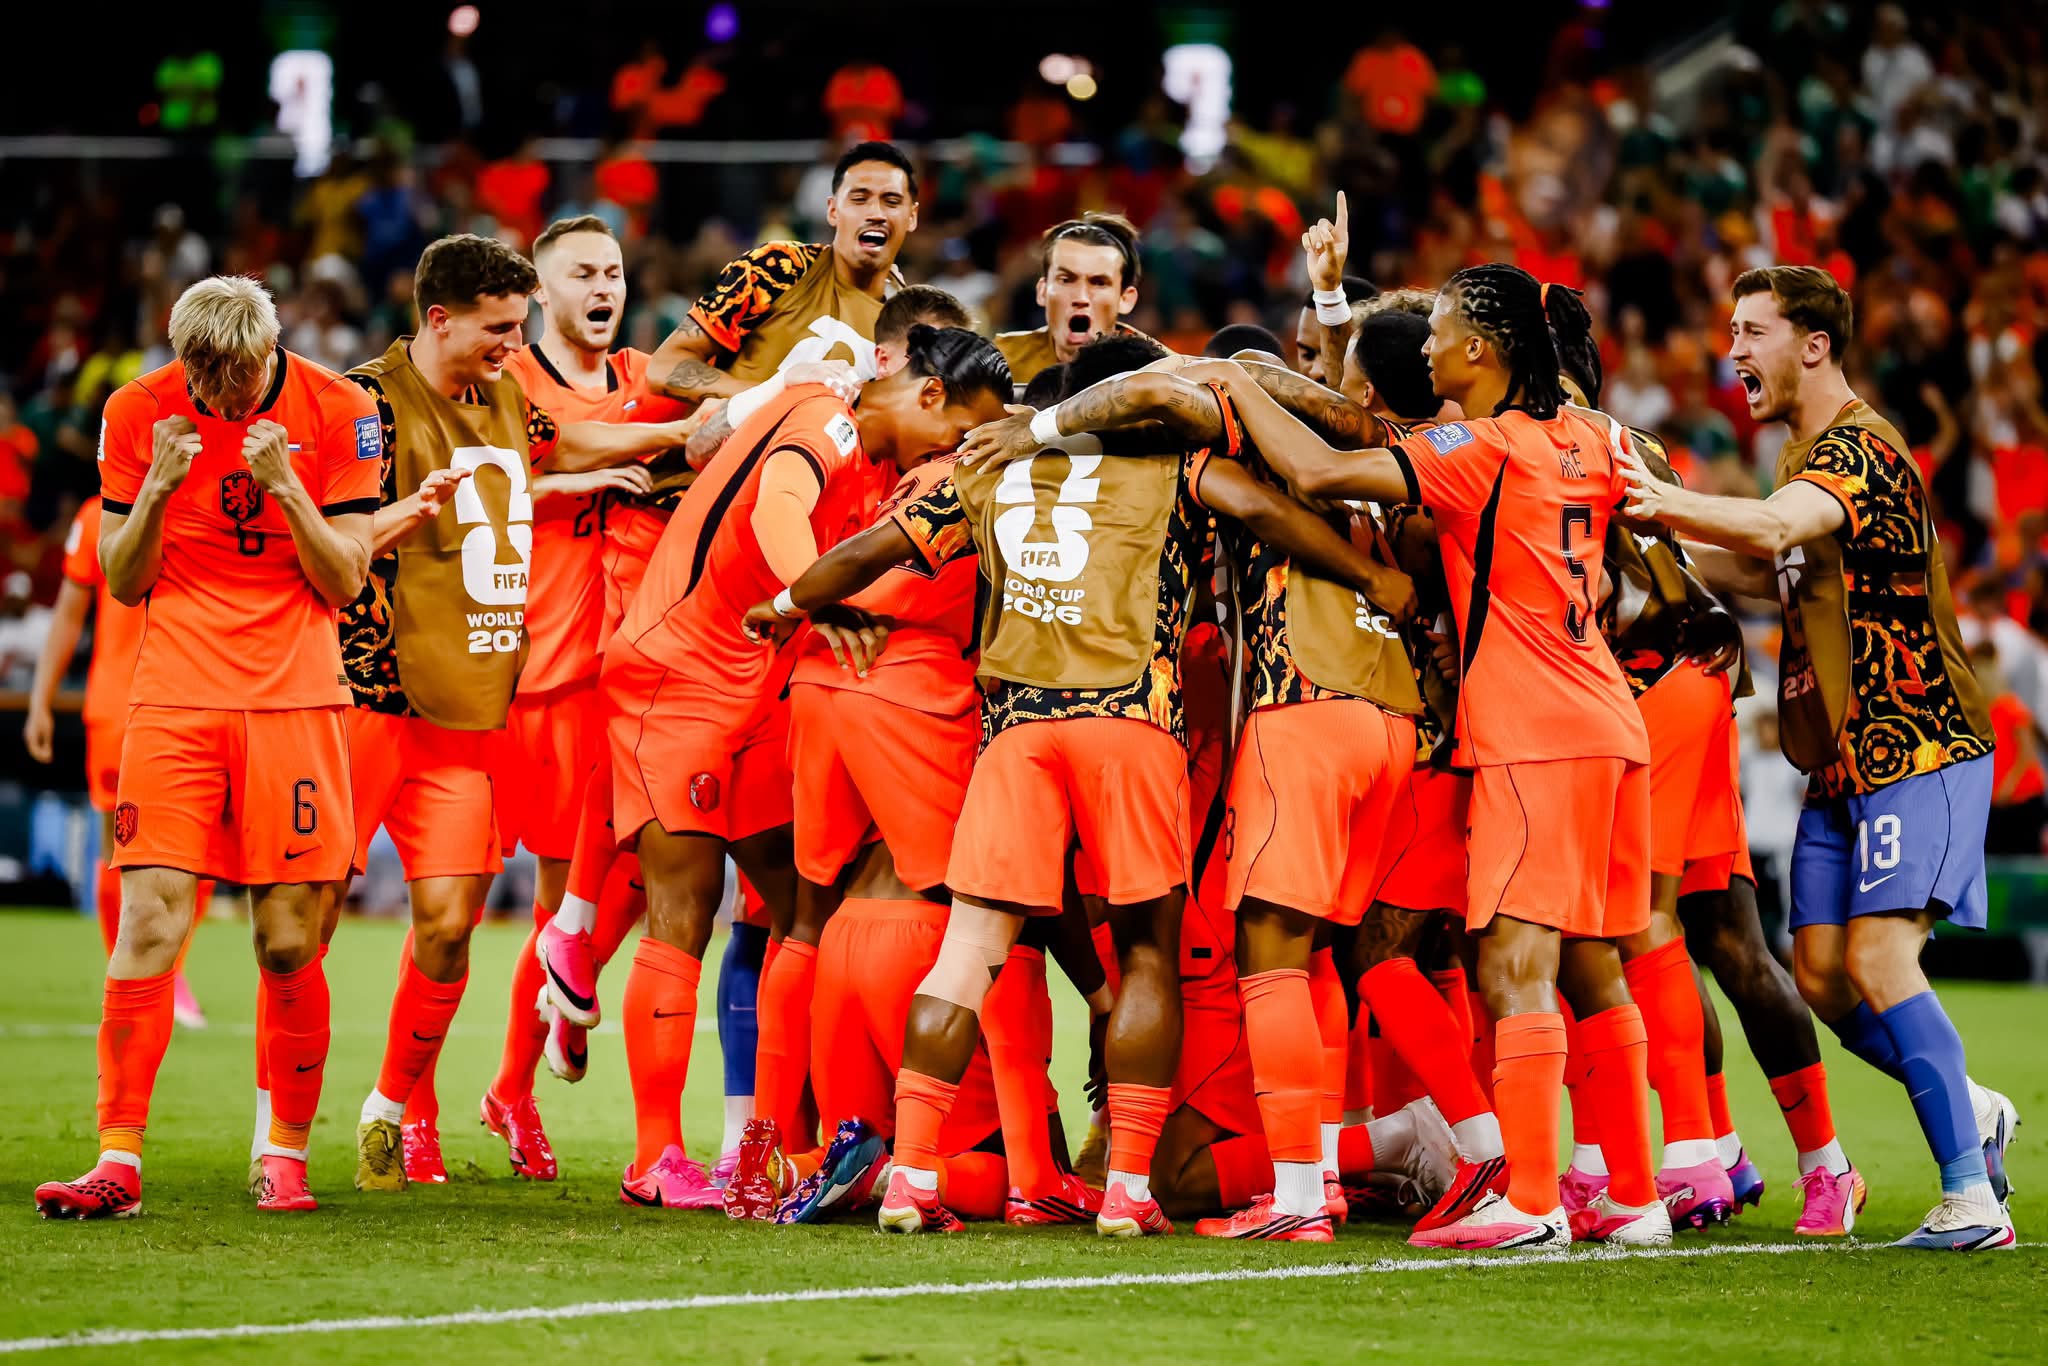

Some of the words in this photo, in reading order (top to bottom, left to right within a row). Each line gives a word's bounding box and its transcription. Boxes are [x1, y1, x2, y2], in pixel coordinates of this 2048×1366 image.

[1021, 550, 1061, 568] FIFA
[493, 572, 528, 590] FIFA
[1560, 503, 1592, 642] 5
[1049, 588, 1086, 603] CUP
[466, 612, 524, 628] WORLD
[467, 629, 523, 654] 20
[293, 778, 317, 835] 6
[1858, 813, 1902, 873] 13
